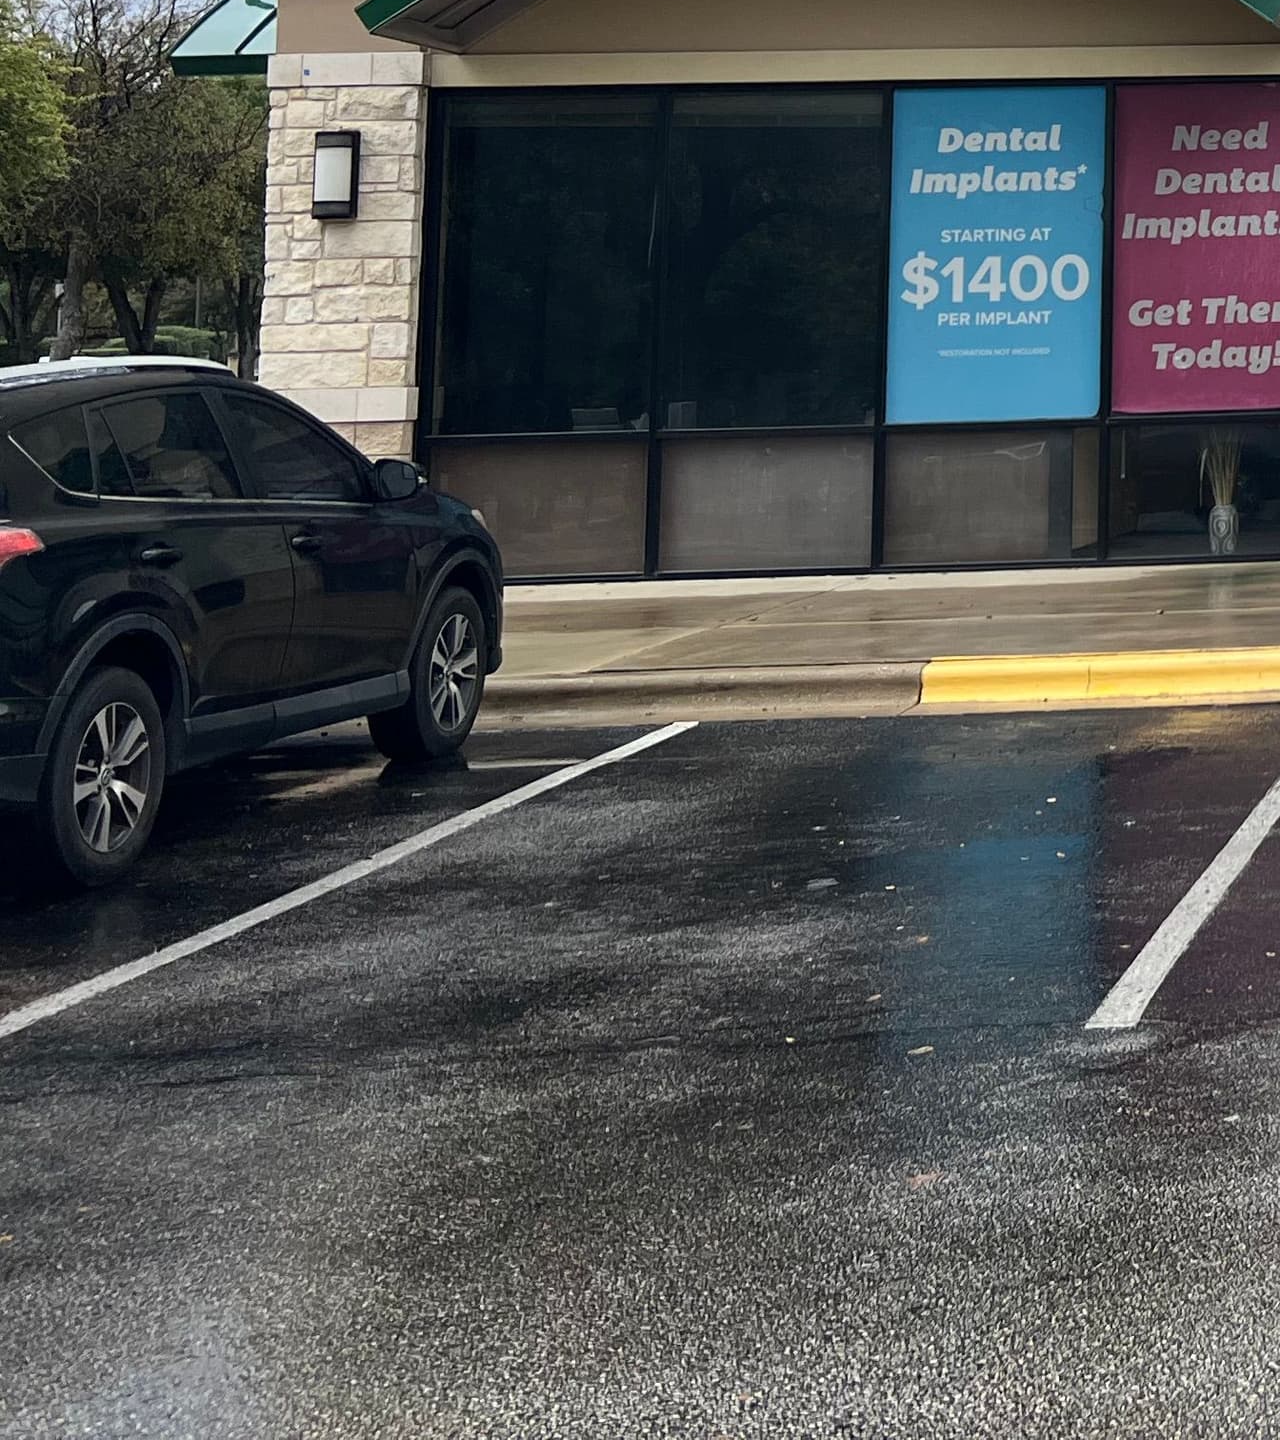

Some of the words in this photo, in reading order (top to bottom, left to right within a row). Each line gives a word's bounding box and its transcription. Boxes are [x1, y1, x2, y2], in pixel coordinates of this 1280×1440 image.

[937, 124, 1062, 154] Dental
[1171, 121, 1269, 152] Need
[940, 228, 1026, 244] STARTING
[1030, 228, 1052, 242] AT
[901, 251, 1090, 310] $1400
[937, 312, 971, 327] PER
[975, 310, 1052, 327] IMPLANT
[1128, 299, 1192, 328] Get
